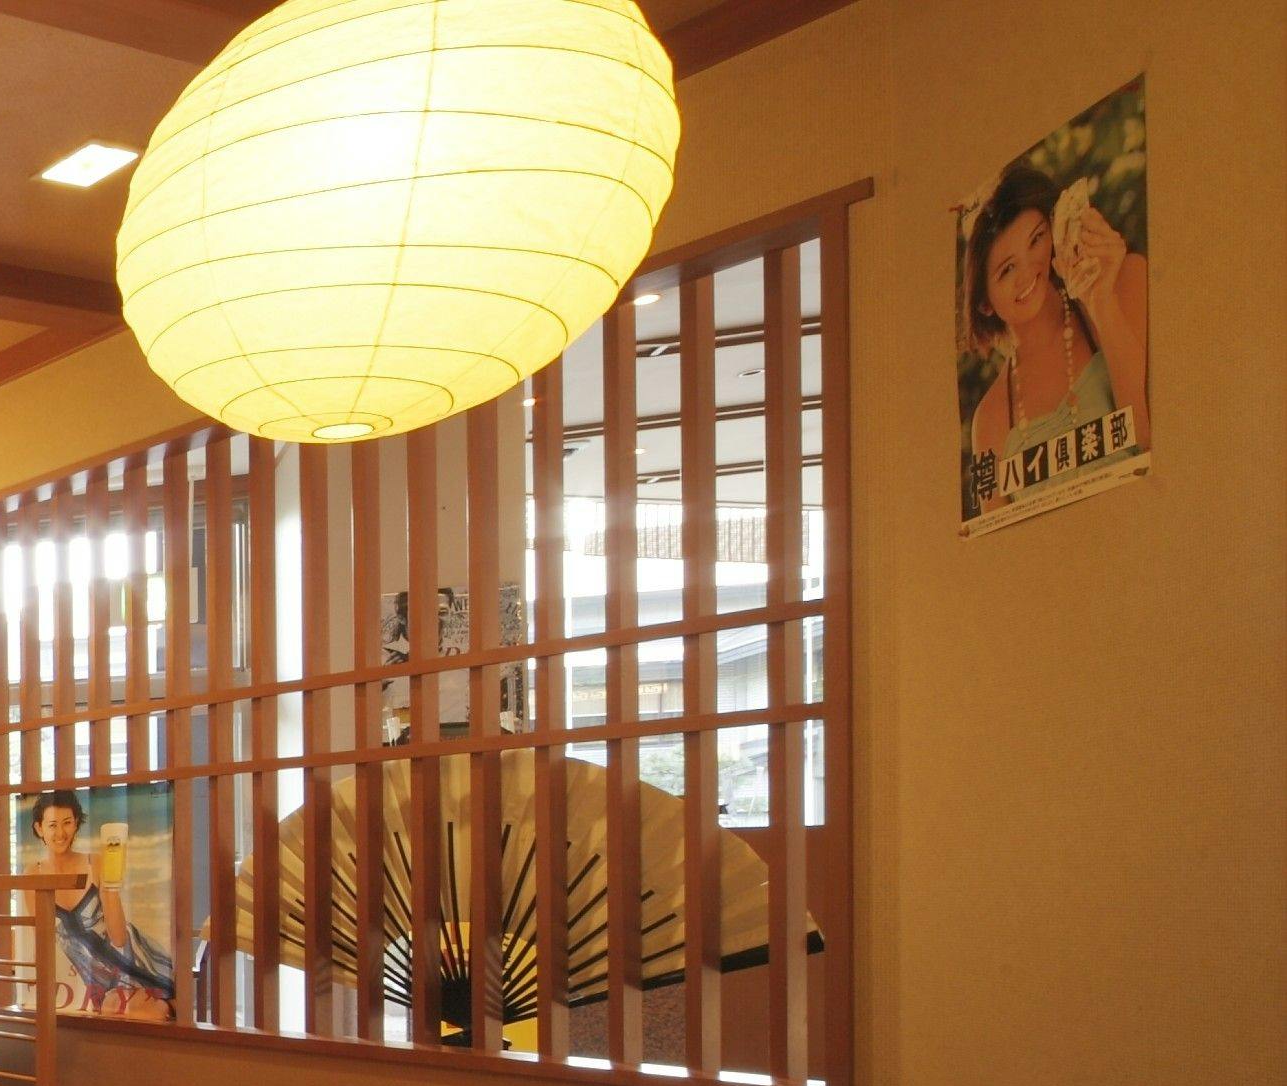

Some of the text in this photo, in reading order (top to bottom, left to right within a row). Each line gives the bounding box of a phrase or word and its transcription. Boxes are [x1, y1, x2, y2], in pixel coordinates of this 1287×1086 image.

[971, 412, 1129, 501] 樽ハイ倶楽部
